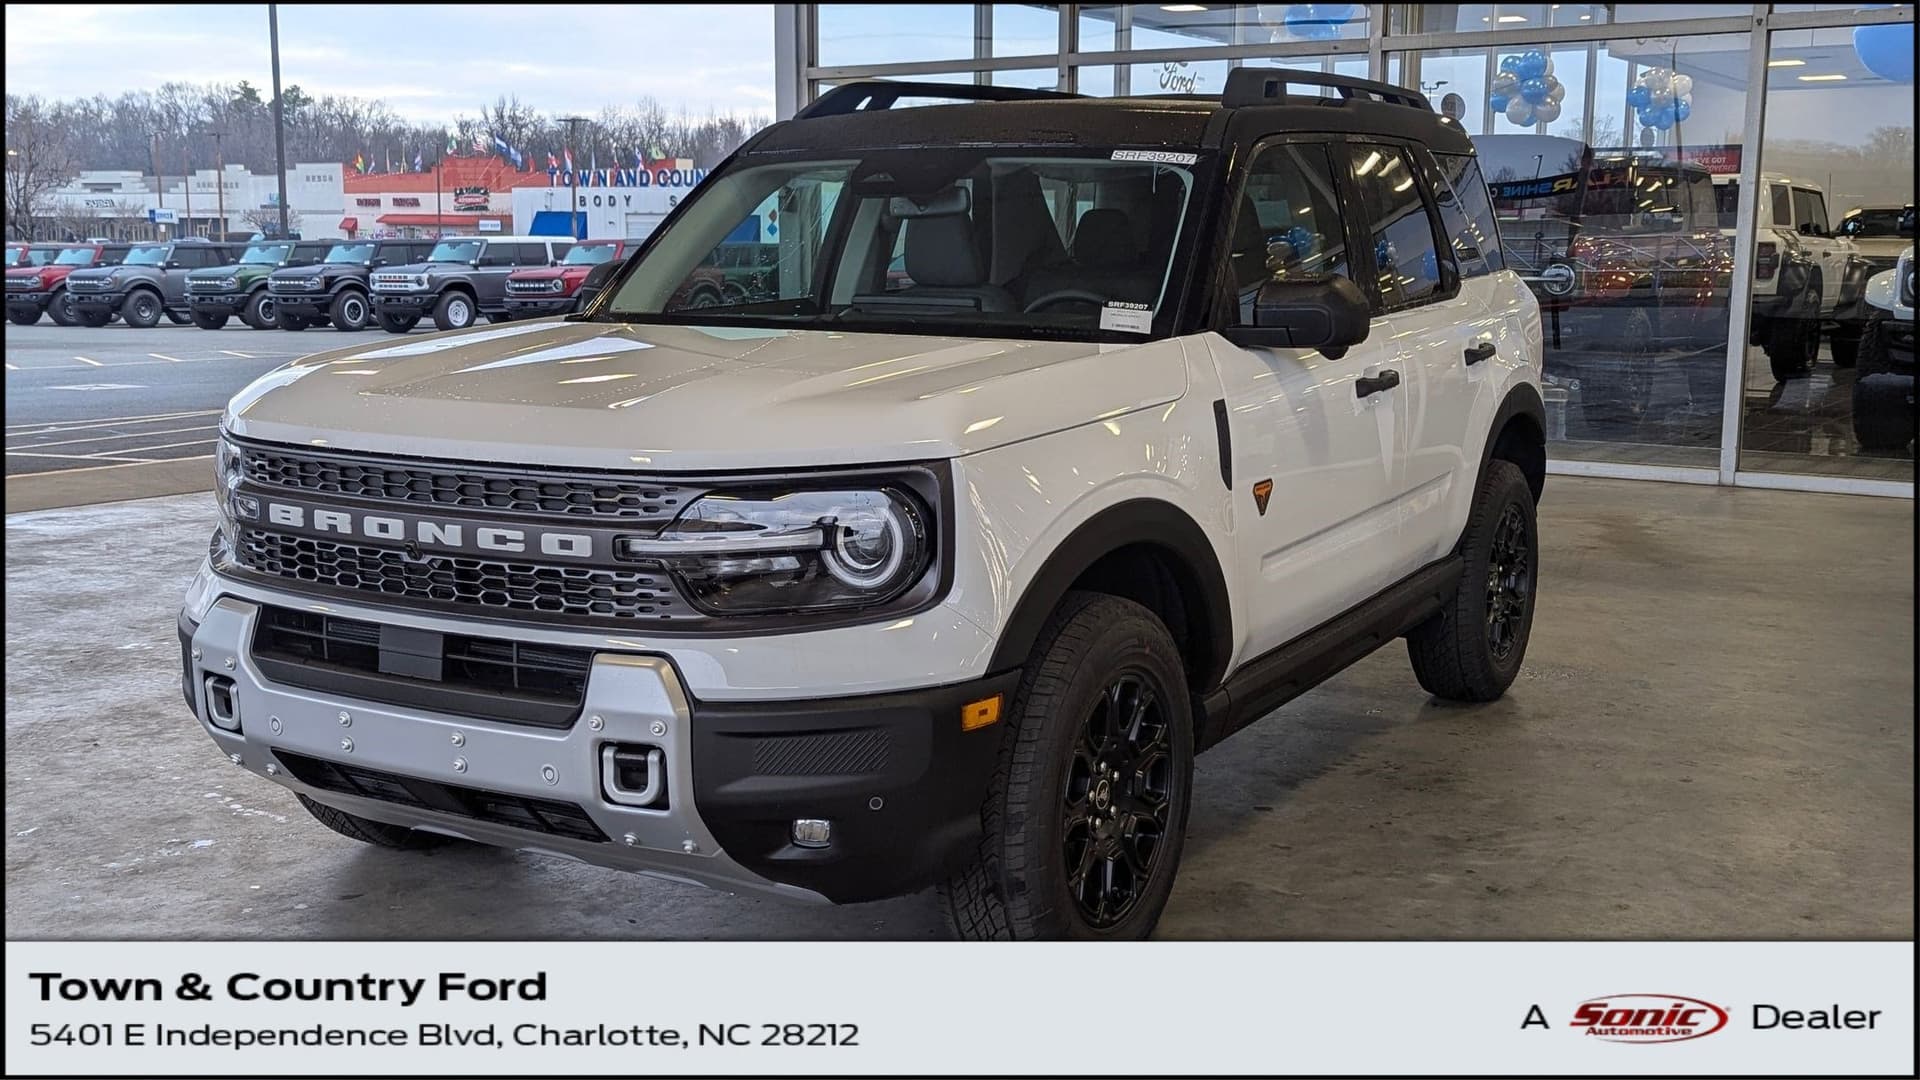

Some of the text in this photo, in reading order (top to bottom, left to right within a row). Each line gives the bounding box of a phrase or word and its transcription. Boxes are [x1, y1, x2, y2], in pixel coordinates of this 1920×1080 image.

[1112, 150, 1196, 163] SRF39207
[1711, 156, 1727, 164] GOT
[548, 167, 707, 187] TOWN AND COUN
[579, 195, 632, 207] BODY
[269, 503, 592, 558] BRONCO
